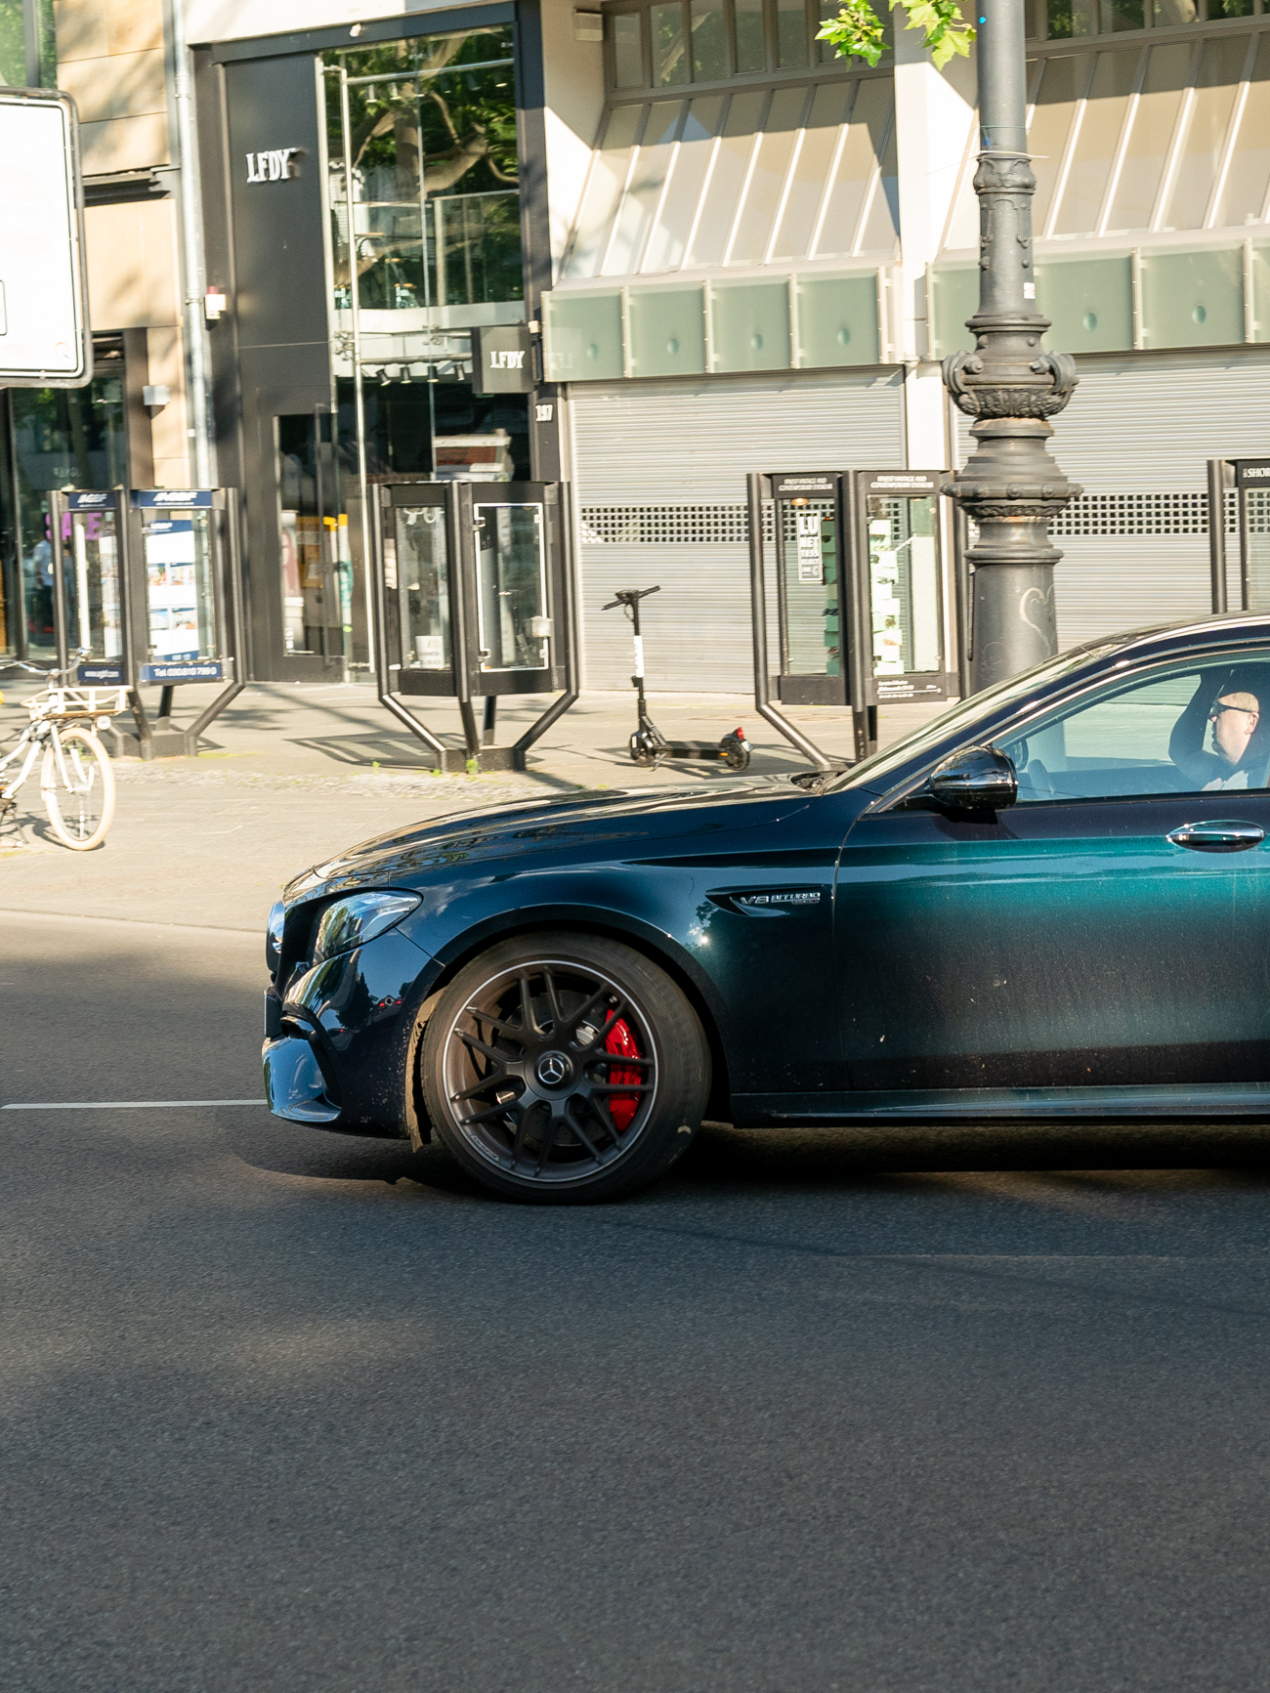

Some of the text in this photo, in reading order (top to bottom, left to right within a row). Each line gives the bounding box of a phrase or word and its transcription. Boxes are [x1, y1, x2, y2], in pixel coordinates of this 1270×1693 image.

[245, 148, 293, 182] LFDY
[489, 350, 526, 369] LFDY
[535, 404, 553, 422] 197
[739, 895, 770, 905] V8
